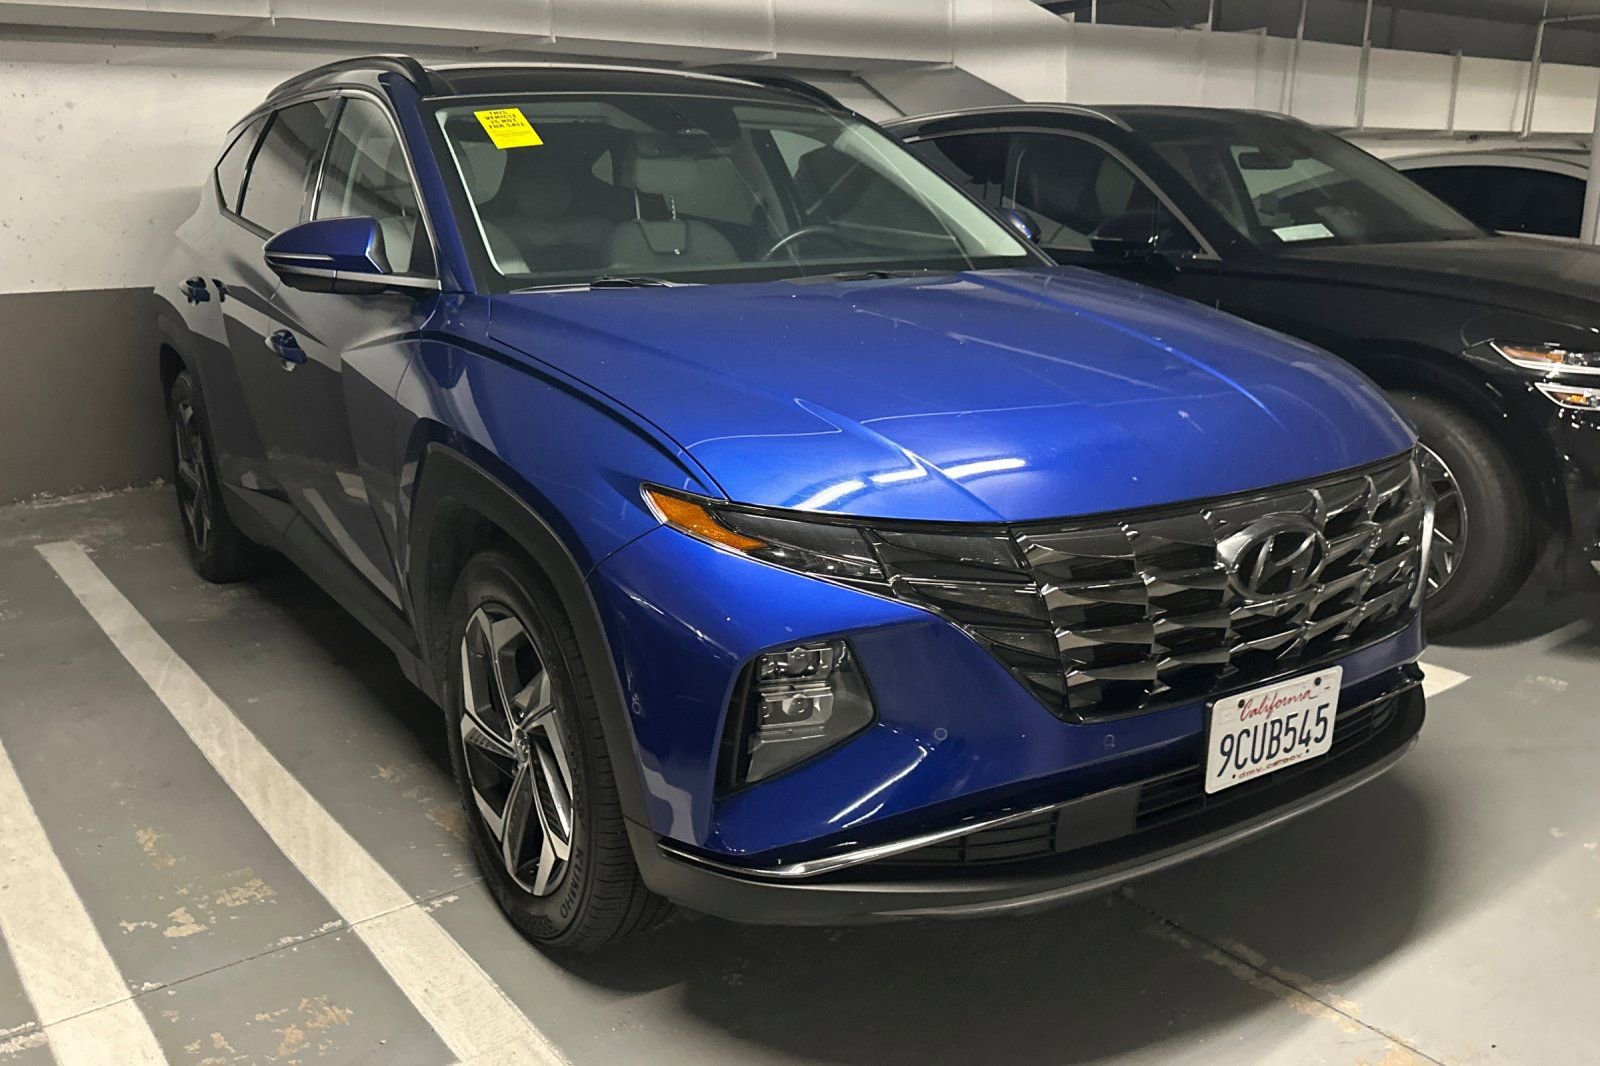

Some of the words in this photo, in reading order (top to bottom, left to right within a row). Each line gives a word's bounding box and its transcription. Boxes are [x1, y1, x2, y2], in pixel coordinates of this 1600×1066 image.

[1217, 702, 1330, 778] 9CUB545
[1239, 689, 1318, 722] California
[560, 846, 584, 919] KUMHO
